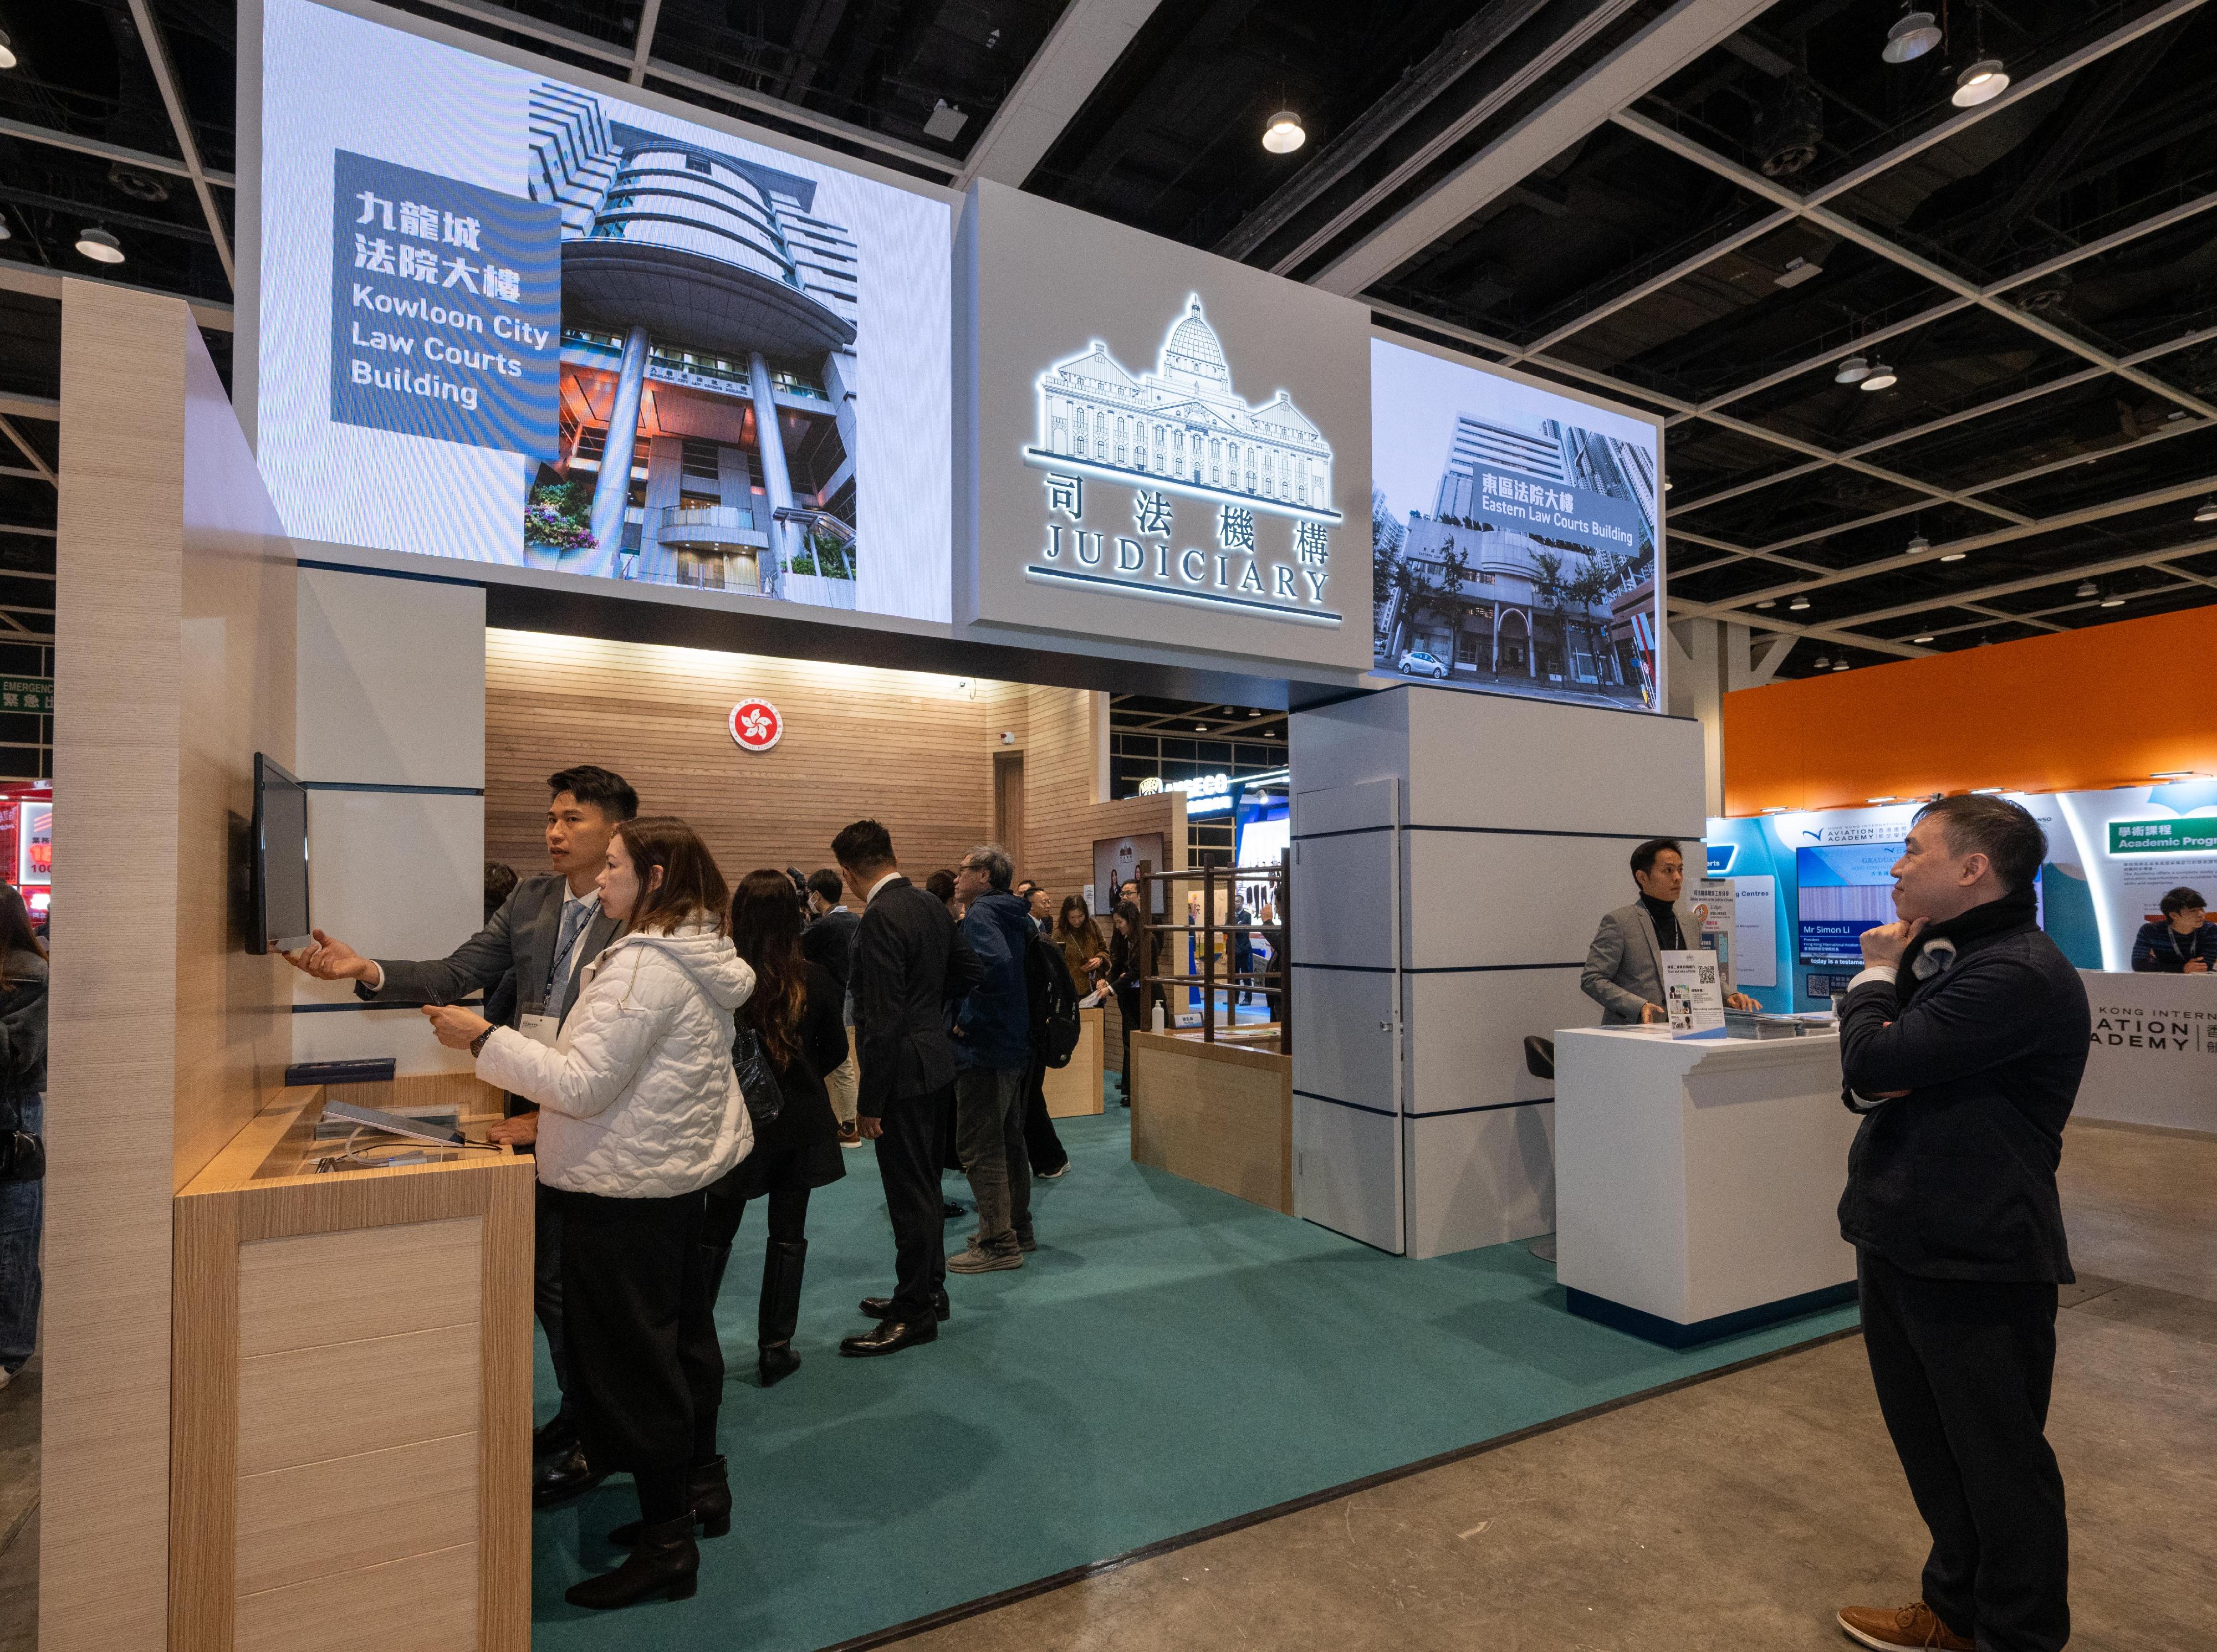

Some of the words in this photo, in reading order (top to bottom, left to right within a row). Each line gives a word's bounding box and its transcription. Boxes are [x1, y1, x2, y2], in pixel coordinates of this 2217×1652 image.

[356, 191, 481, 252] 九龍城
[354, 233, 521, 304] 法院大樓
[353, 283, 483, 333] Kowloon
[493, 314, 549, 351] City
[352, 323, 413, 355] Law
[424, 336, 522, 377] Courts
[352, 359, 478, 410] Building
[1046, 473, 1329, 565] 司法機構
[1482, 473, 1574, 514] 東區法院大樓
[1483, 495, 1526, 519] Eastern
[1529, 505, 1551, 524] Law
[1554, 513, 1589, 533] Courts
[1592, 521, 1633, 547] Building
[1047, 525, 1329, 602] JUDICIARY
[2118, 825, 2172, 837] 學術課程
[2119, 838, 2179, 848] Academic
[2097, 1017, 2188, 1035] ATION
[2099, 1006, 2144, 1016] KONG
[2153, 1010, 2217, 1020] INTERN
[2090, 1032, 2189, 1051] ADEMY
